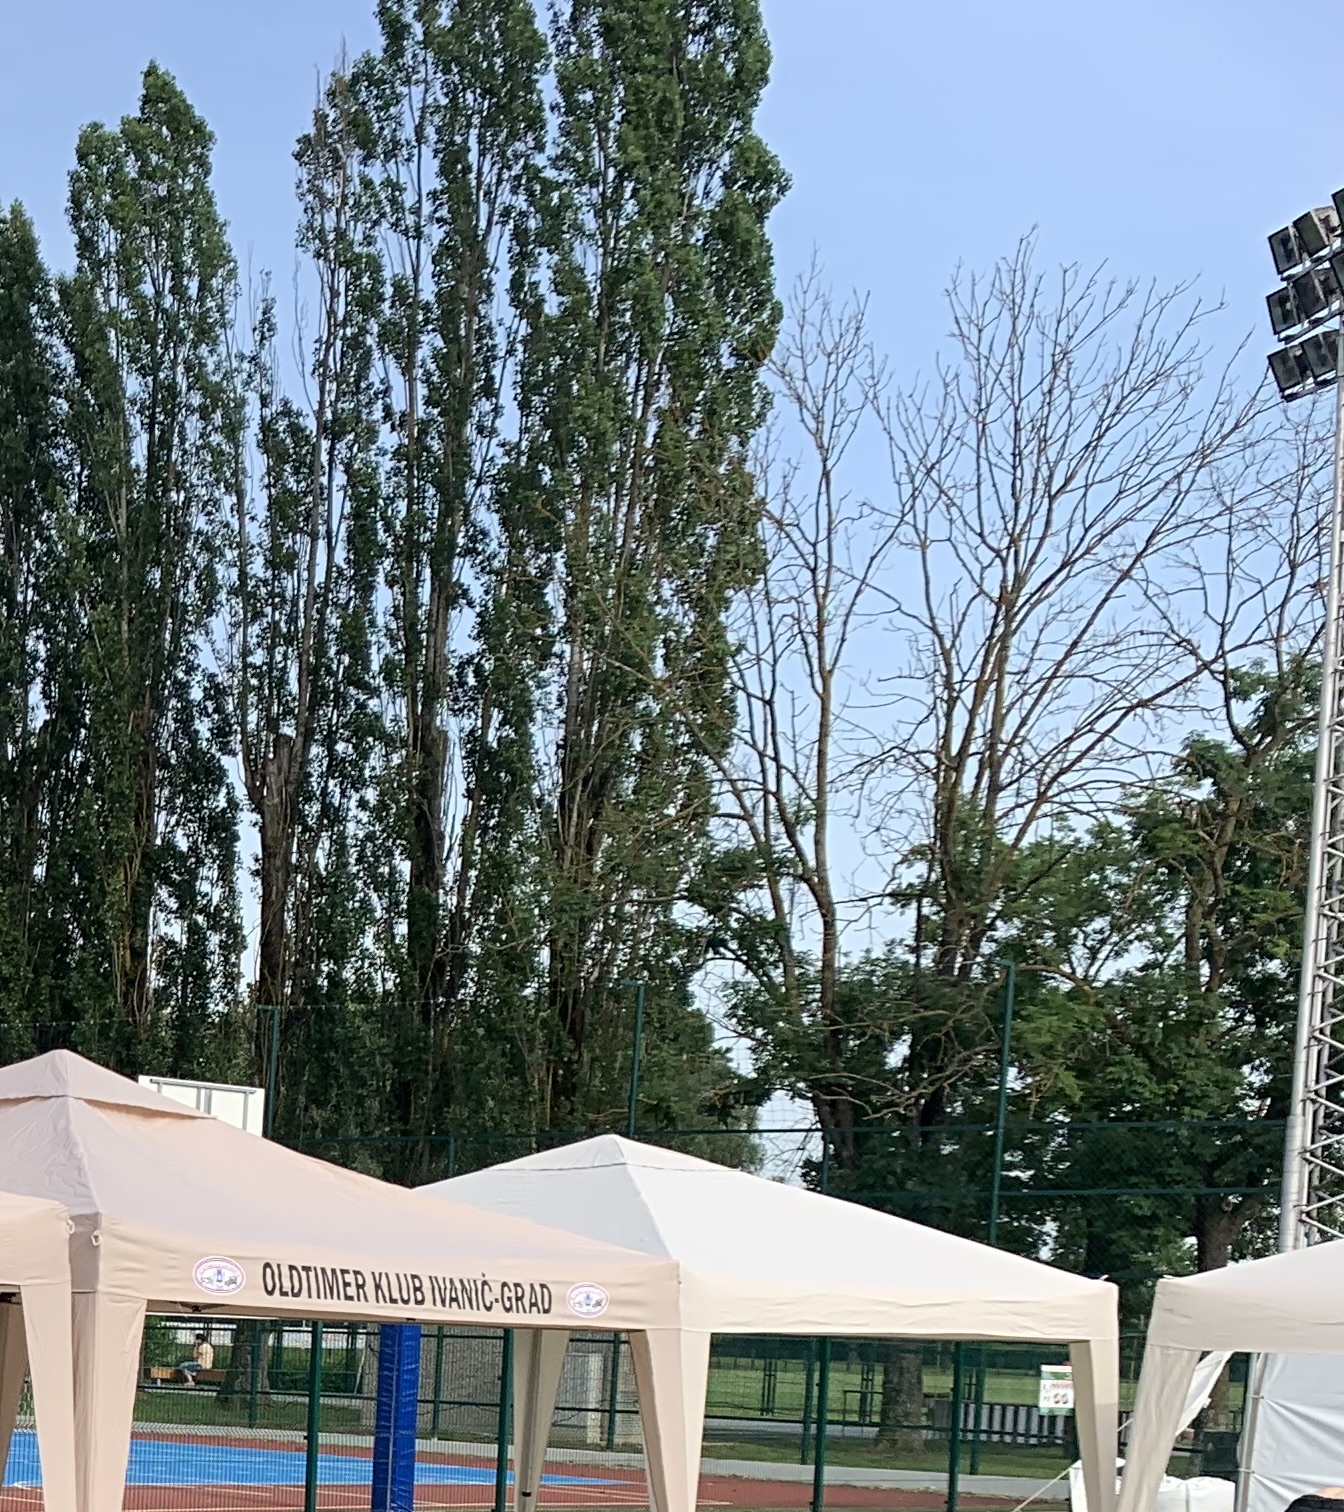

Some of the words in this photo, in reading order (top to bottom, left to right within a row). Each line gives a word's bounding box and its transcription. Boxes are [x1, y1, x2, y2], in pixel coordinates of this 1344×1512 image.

[262, 1261, 369, 1303] OLDTIMER
[371, 1271, 426, 1306] KLUB
[428, 1272, 552, 1315] IVANIĆ-GRAD
